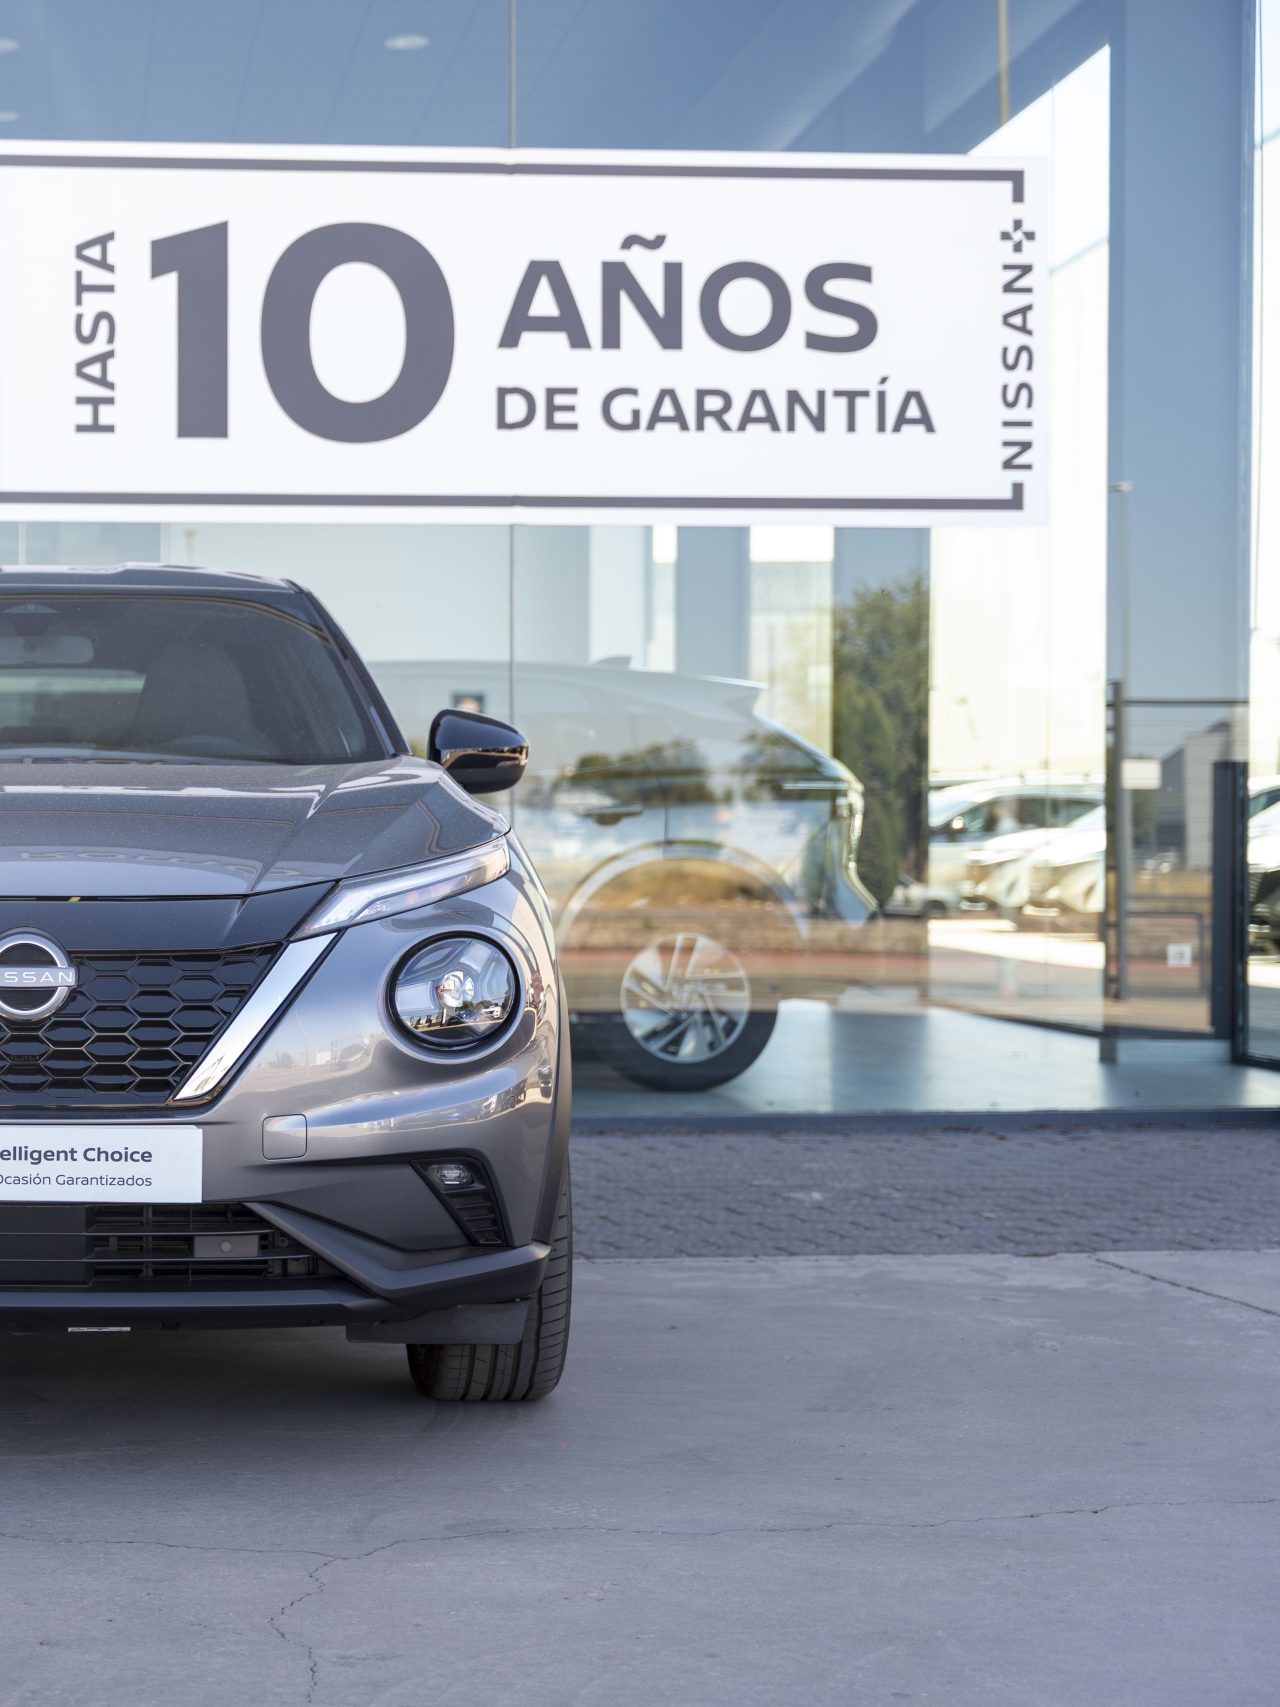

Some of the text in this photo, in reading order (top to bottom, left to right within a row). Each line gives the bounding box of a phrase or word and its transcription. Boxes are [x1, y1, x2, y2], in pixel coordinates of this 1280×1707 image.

[74, 230, 116, 435] HASTA
[150, 220, 880, 445] 10 AÑOS
[495, 375, 937, 434] DE GARANTÍA
[55, 1174, 152, 1187] Garantizados
[83, 1147, 153, 1163] Choice
